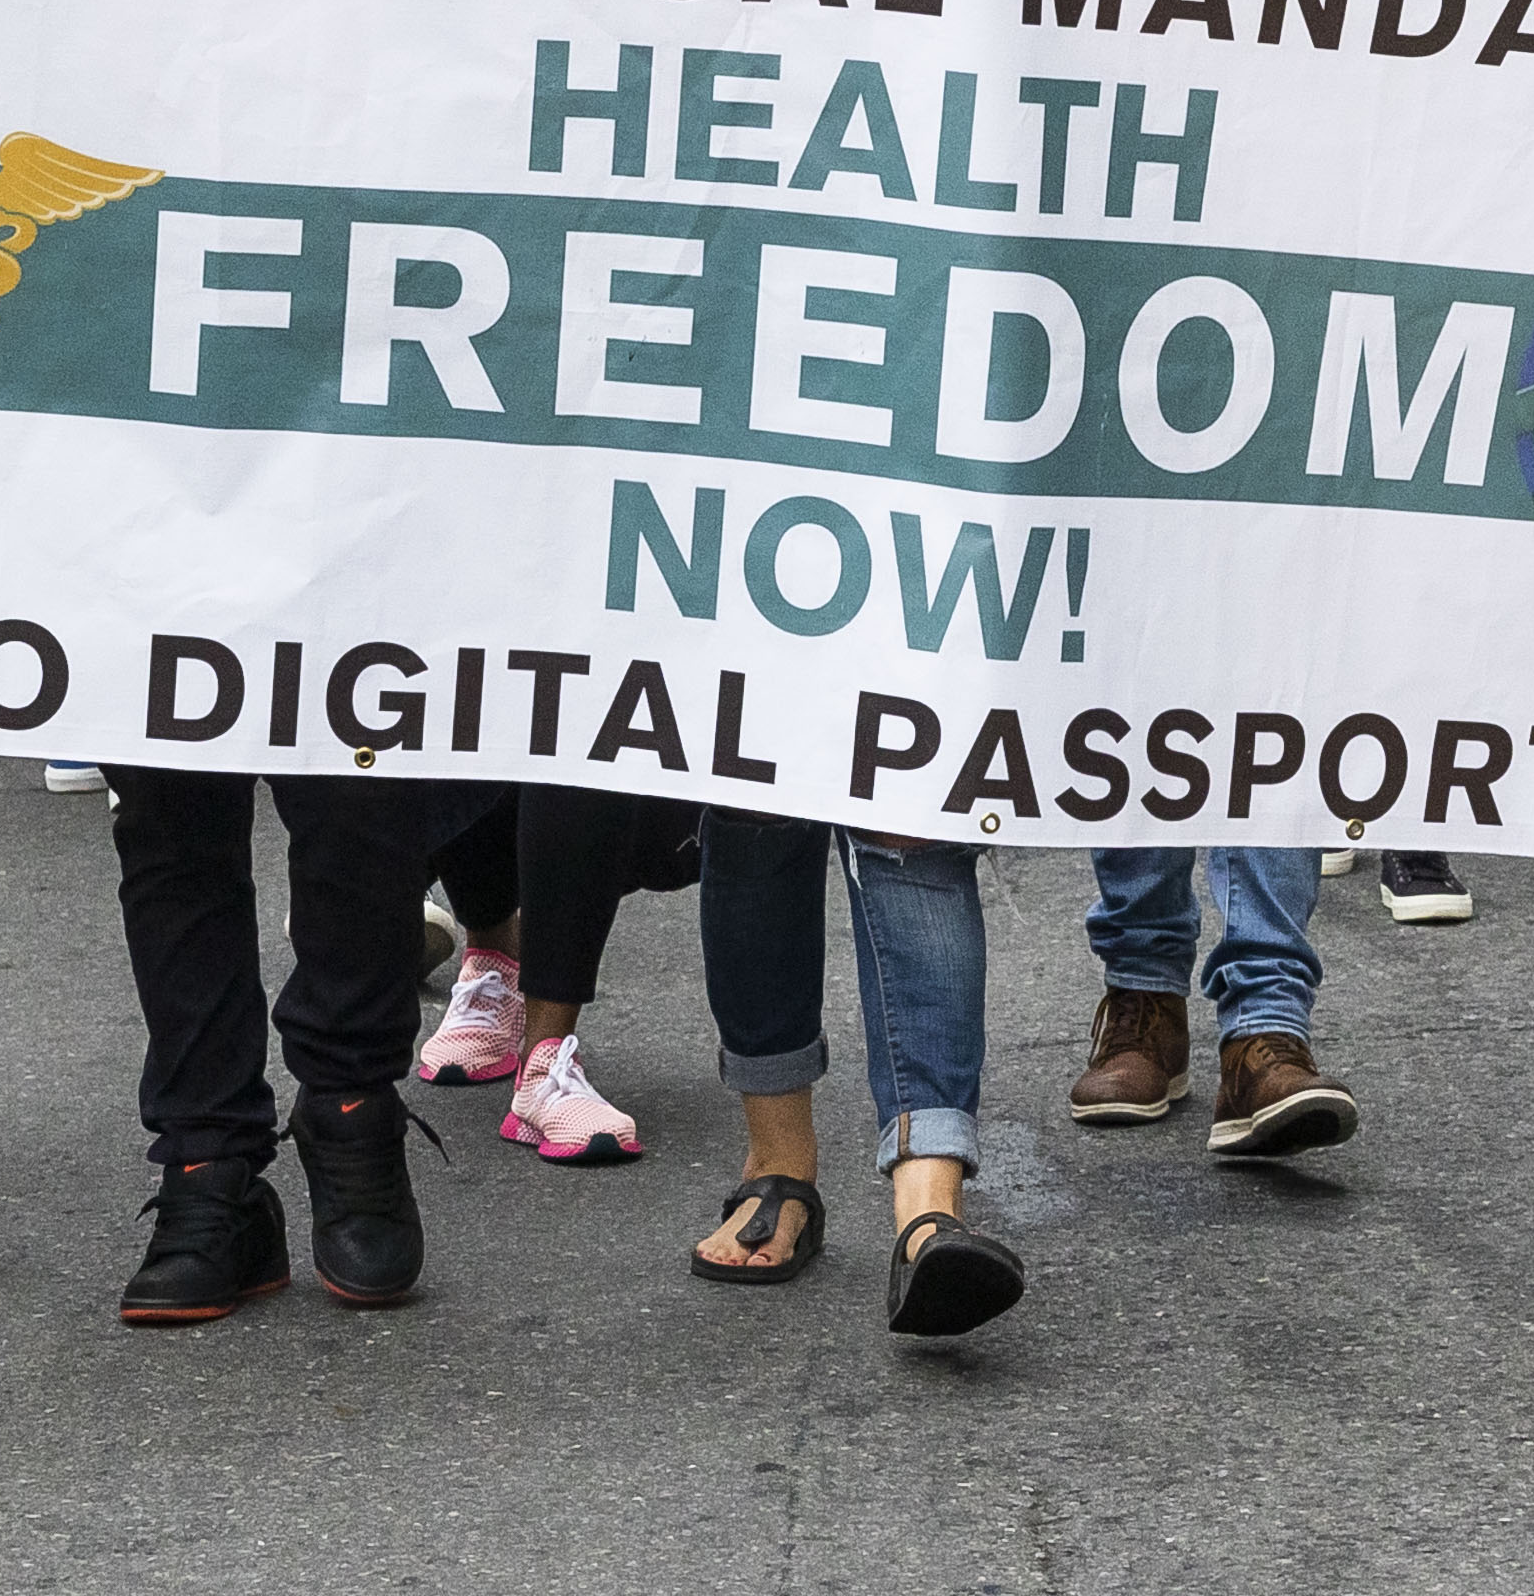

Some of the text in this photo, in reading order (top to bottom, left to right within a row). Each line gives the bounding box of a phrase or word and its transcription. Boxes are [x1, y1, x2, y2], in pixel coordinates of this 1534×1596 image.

[526, 38, 1220, 223] HEALTH
[147, 209, 1516, 488] FREEDOM
[602, 478, 1092, 665] NOW!
[144, 631, 779, 786] DIGITAL
